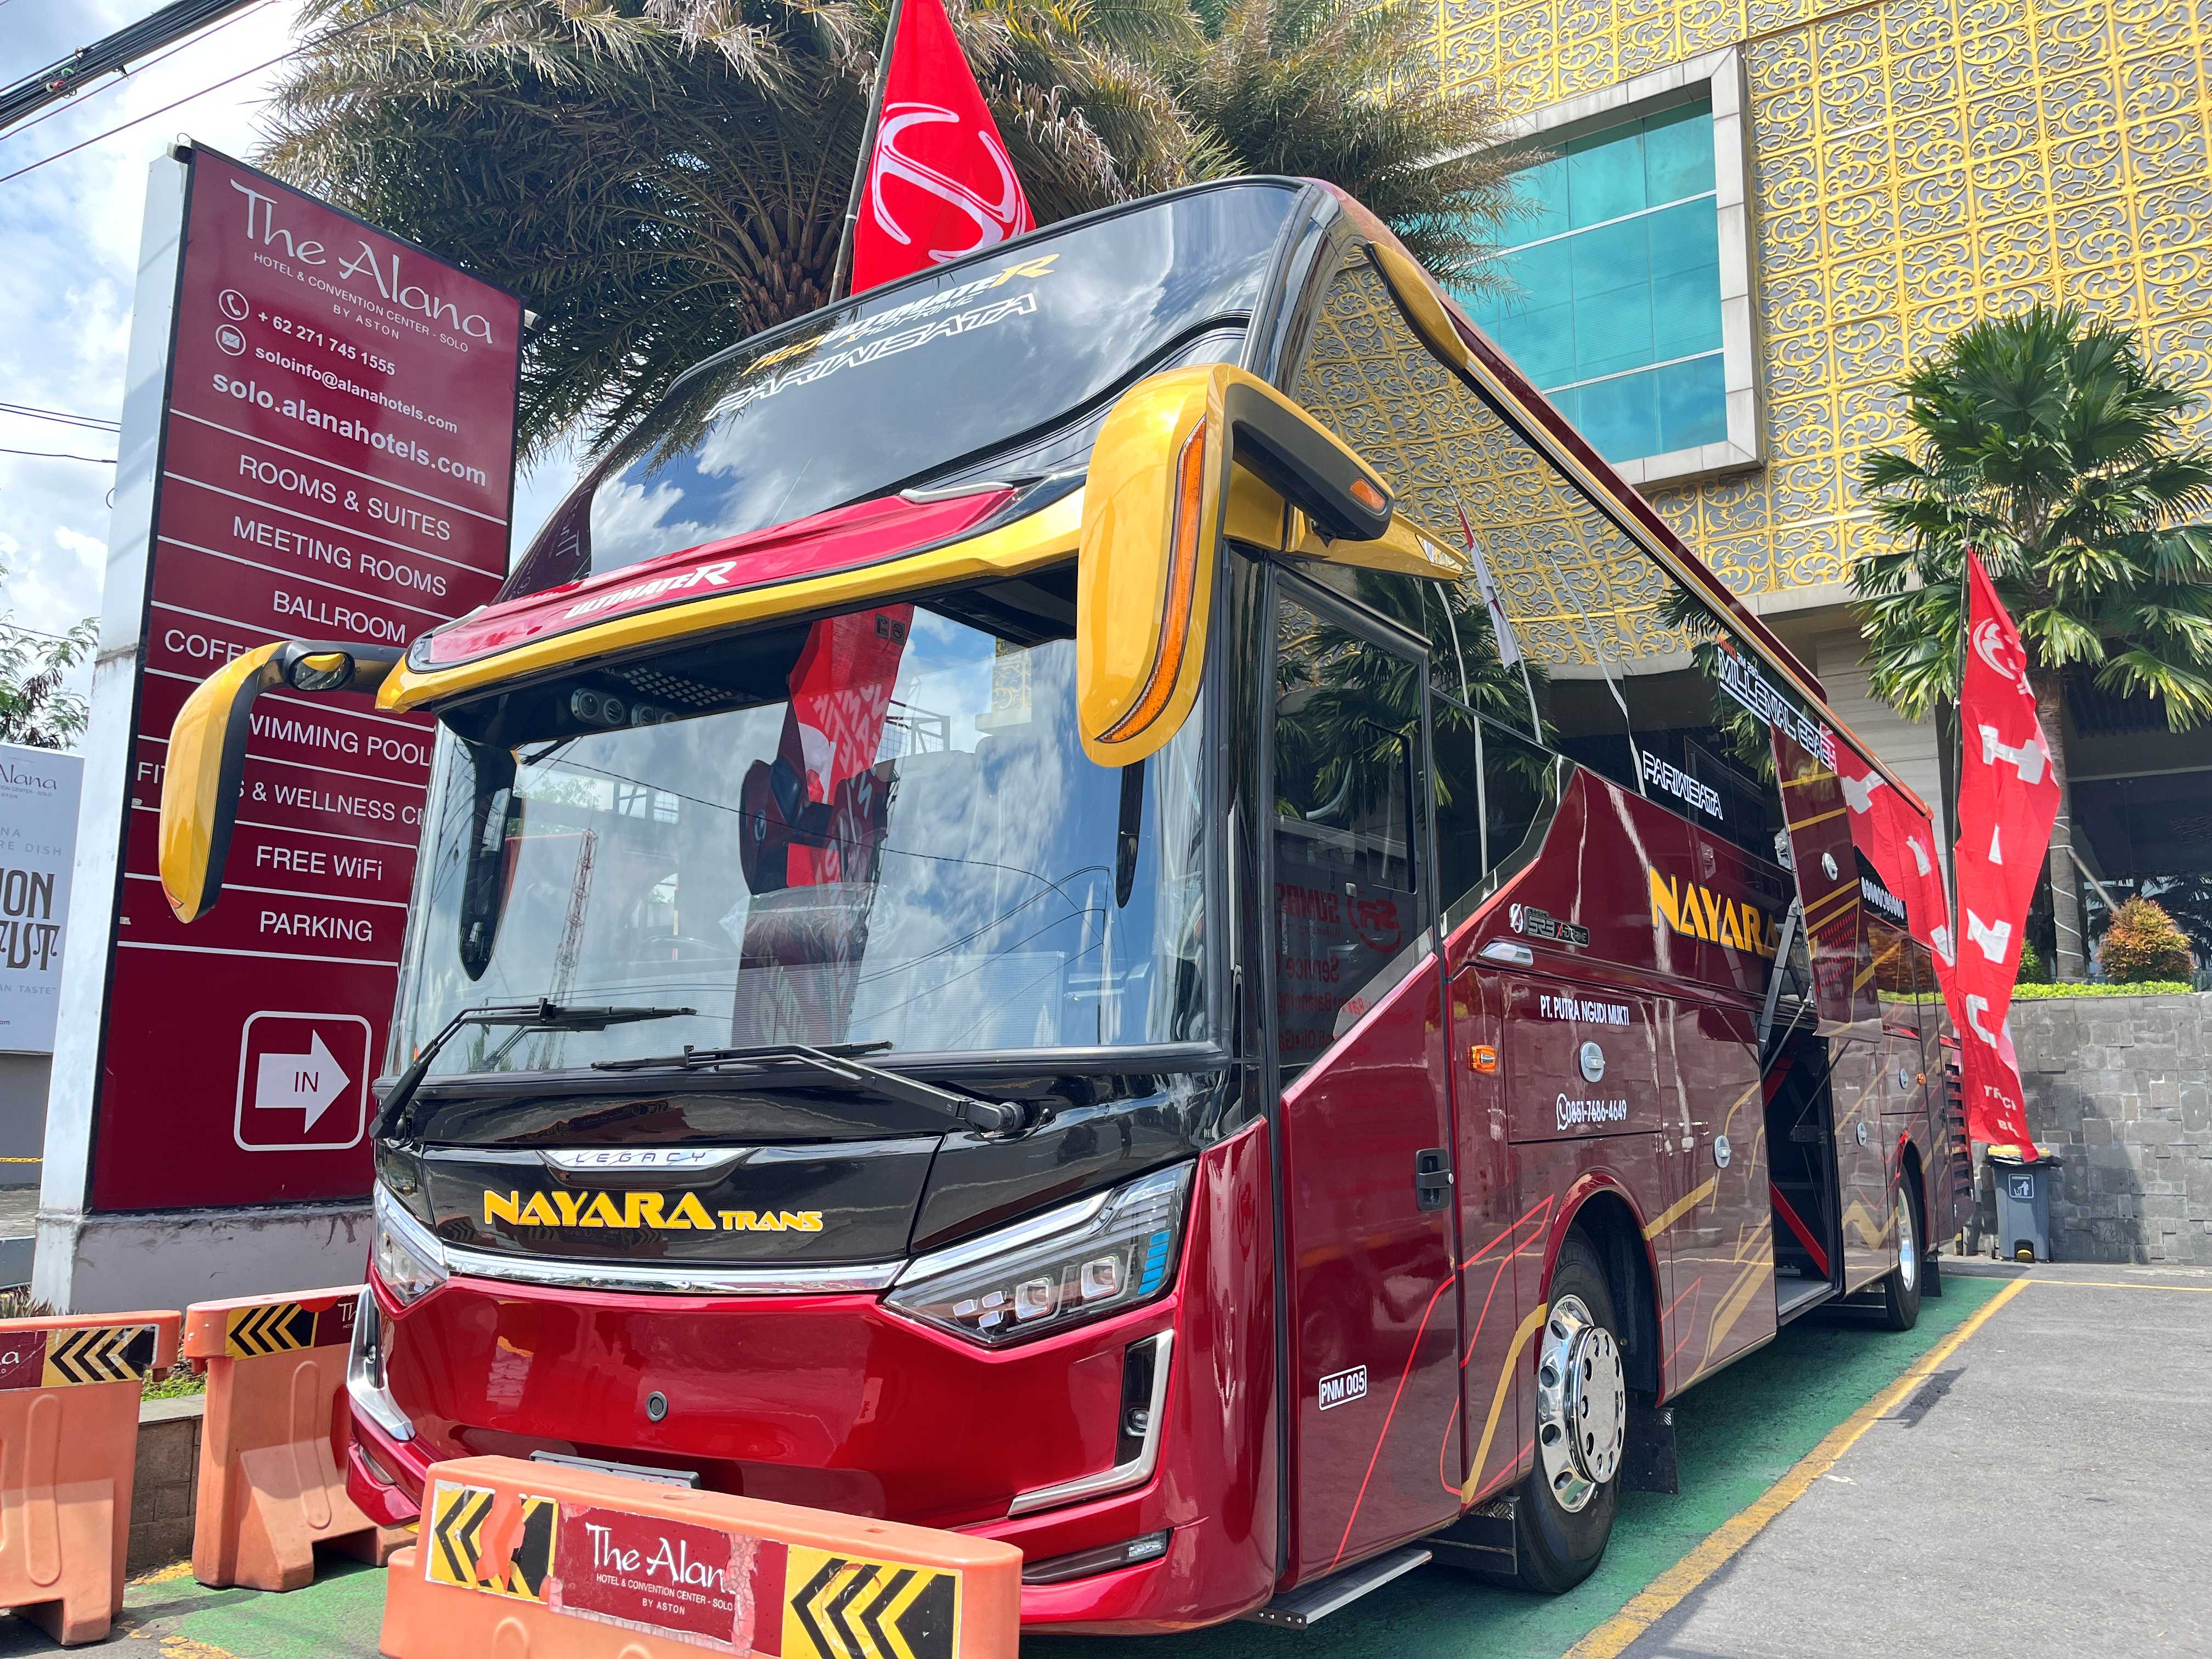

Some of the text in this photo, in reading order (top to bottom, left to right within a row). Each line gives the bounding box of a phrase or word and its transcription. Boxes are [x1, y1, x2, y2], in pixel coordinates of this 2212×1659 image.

[230, 179, 493, 344] The Alana
[253, 252, 293, 276] HOTEL
[297, 272, 305, 283] &
[308, 275, 383, 318] CONVENTION
[387, 310, 428, 335] CENTER
[440, 334, 468, 353] SOLO
[333, 304, 399, 340] BY ASTON
[258, 312, 395, 376] + 62 271 745 1555
[255, 346, 458, 433] soloinfo@alanahotels.com
[212, 373, 487, 487] solo.alanahotels.com
[239, 454, 451, 541] ROOMS & SUITES
[233, 516, 446, 596] MEETING ROOMS
[273, 590, 406, 644] BALLROOM
[250, 713, 430, 766] WIMMING POOL
[252, 782, 267, 802] &
[274, 784, 395, 821] WELLNESS
[25, 843, 62, 856] DISH
[256, 846, 383, 881] FREE WiFi
[259, 911, 373, 942] PARKING
[1540, 995, 1630, 1026] PT. PUTRA NGUDI MUKTI
[294, 1071, 319, 1092] IN
[575, 1152, 707, 1164] LEGACY
[484, 1189, 823, 1232] NAYARA TRANS
[1321, 1371, 1365, 1404] PNM 005
[585, 1521, 640, 1572] The
[597, 1573, 619, 1587] HOTEL
[621, 1578, 626, 1587] &
[628, 1579, 675, 1597] CONVENTION
[676, 1590, 706, 1604] CENTER
[713, 1599, 733, 1611] SOLO
[642, 1598, 685, 1615] BY ASTON
